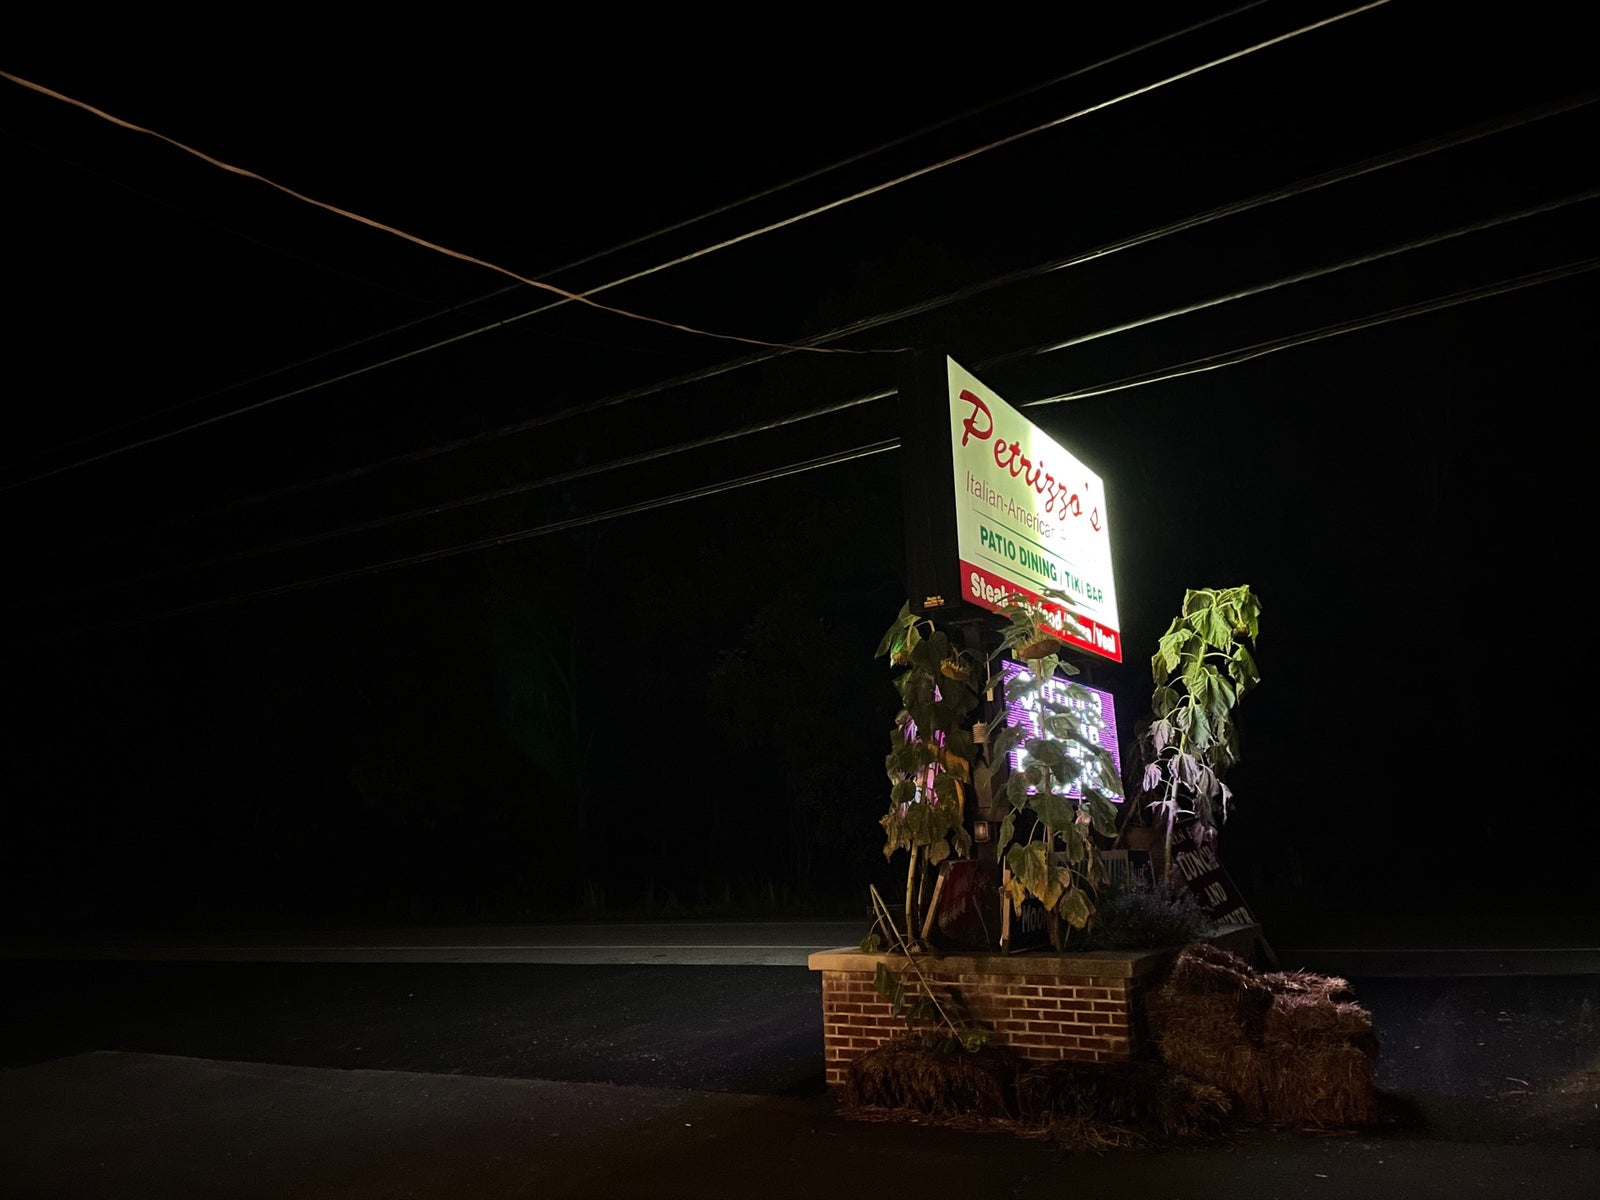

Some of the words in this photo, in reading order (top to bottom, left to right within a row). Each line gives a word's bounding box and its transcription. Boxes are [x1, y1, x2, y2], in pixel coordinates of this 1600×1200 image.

[958, 388, 1102, 532] Petrizzo's
[970, 572, 1009, 608] Steak
[980, 525, 1016, 561] PATIO
[1019, 545, 1058, 582] DINING
[1064, 570, 1084, 595] TIKI
[1086, 582, 1104, 604] BAR
